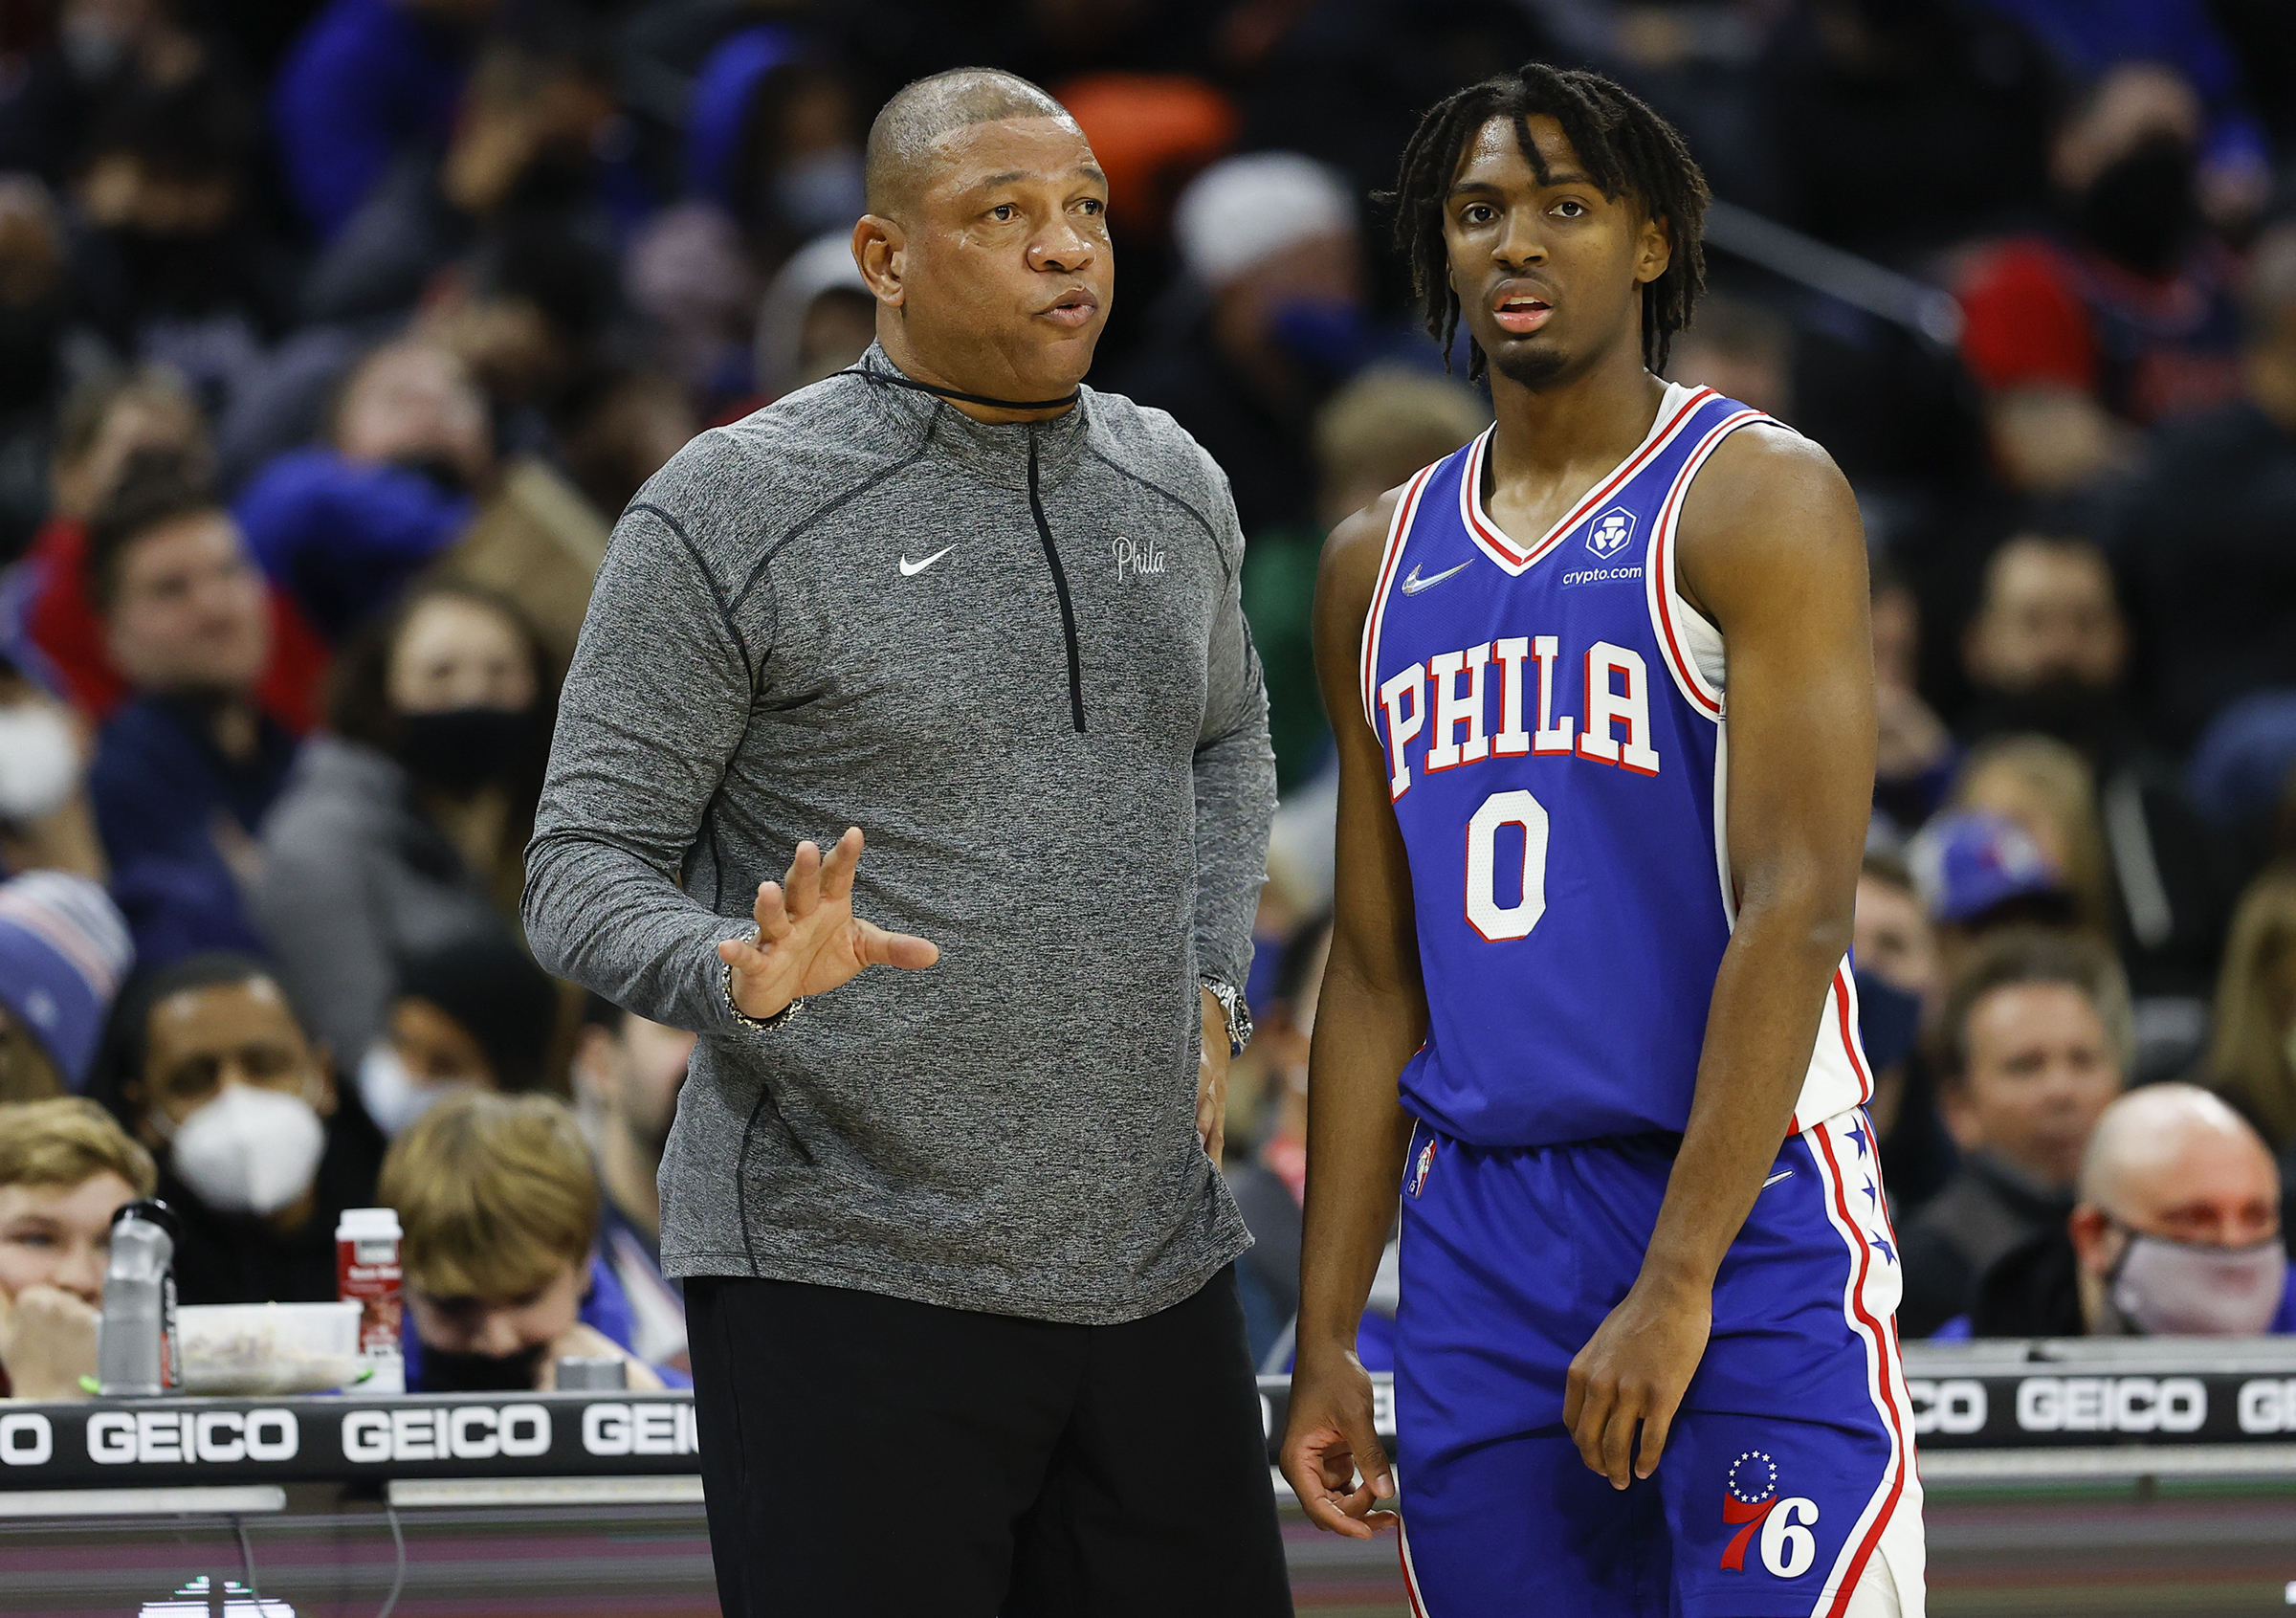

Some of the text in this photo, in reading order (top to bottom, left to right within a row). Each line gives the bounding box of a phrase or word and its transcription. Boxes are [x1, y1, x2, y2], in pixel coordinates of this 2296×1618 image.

[1112, 536, 1166, 582] Phila
[1562, 566, 1643, 585] crypto.com
[1379, 635, 1660, 805] PHILA
[1464, 788, 1550, 943] 0
[86, 1409, 299, 1465] GEICO
[342, 1404, 552, 1464] GEICO
[582, 1402, 699, 1456] GEI
[2016, 1376, 2207, 1434] GEICO
[1720, 1492, 1820, 1579] 76
